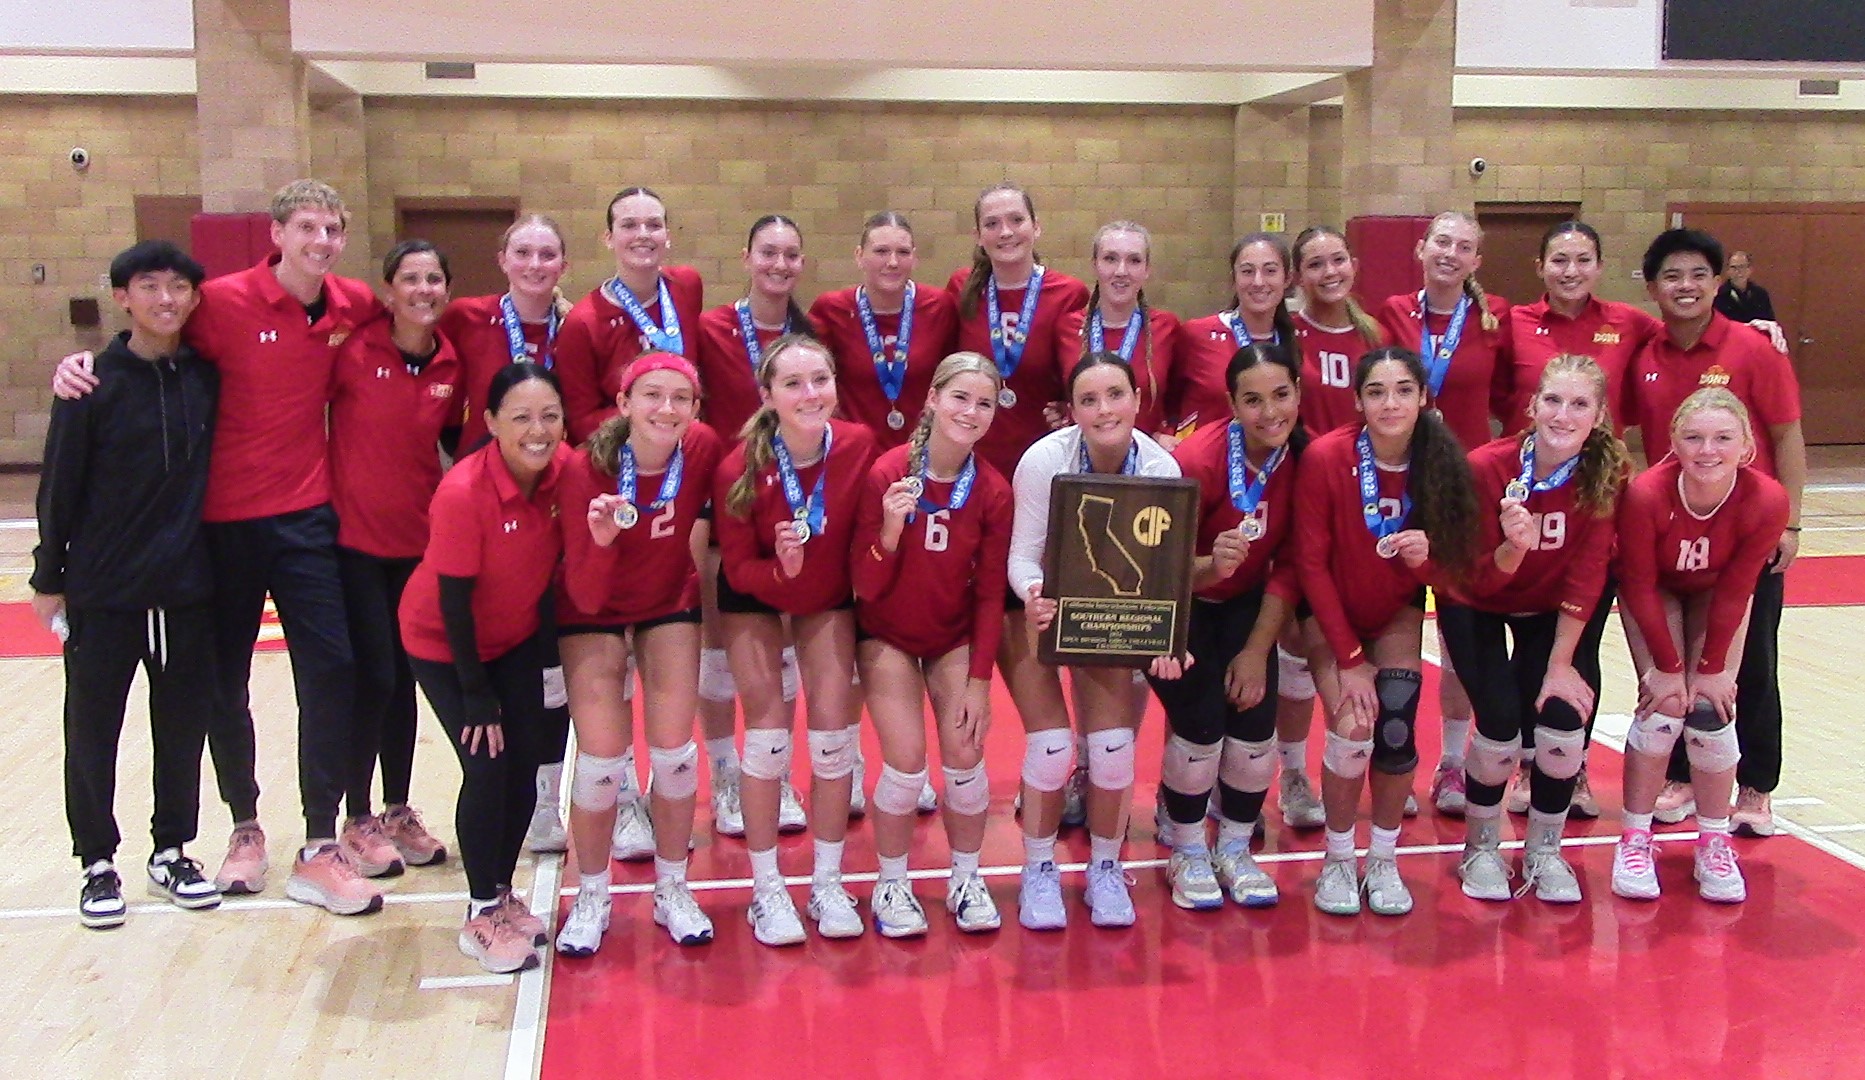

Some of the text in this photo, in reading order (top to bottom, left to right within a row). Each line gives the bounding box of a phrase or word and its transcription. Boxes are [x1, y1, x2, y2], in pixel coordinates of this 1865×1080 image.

[1318, 350, 1350, 388] 10
[774, 444, 801, 501] 2024-2025
[1229, 431, 1242, 486] 2024-2025
[1357, 439, 1376, 498] 2024-2025
[650, 499, 675, 539] 2
[924, 508, 950, 552] 6
[1132, 505, 1172, 547] CIF
[1530, 511, 1566, 551] 19
[1676, 536, 1710, 571] 18
[1070, 612, 1163, 624] SOUTHERN REGIONAL
[1080, 621, 1152, 632] CHAMPIONSHIPS
